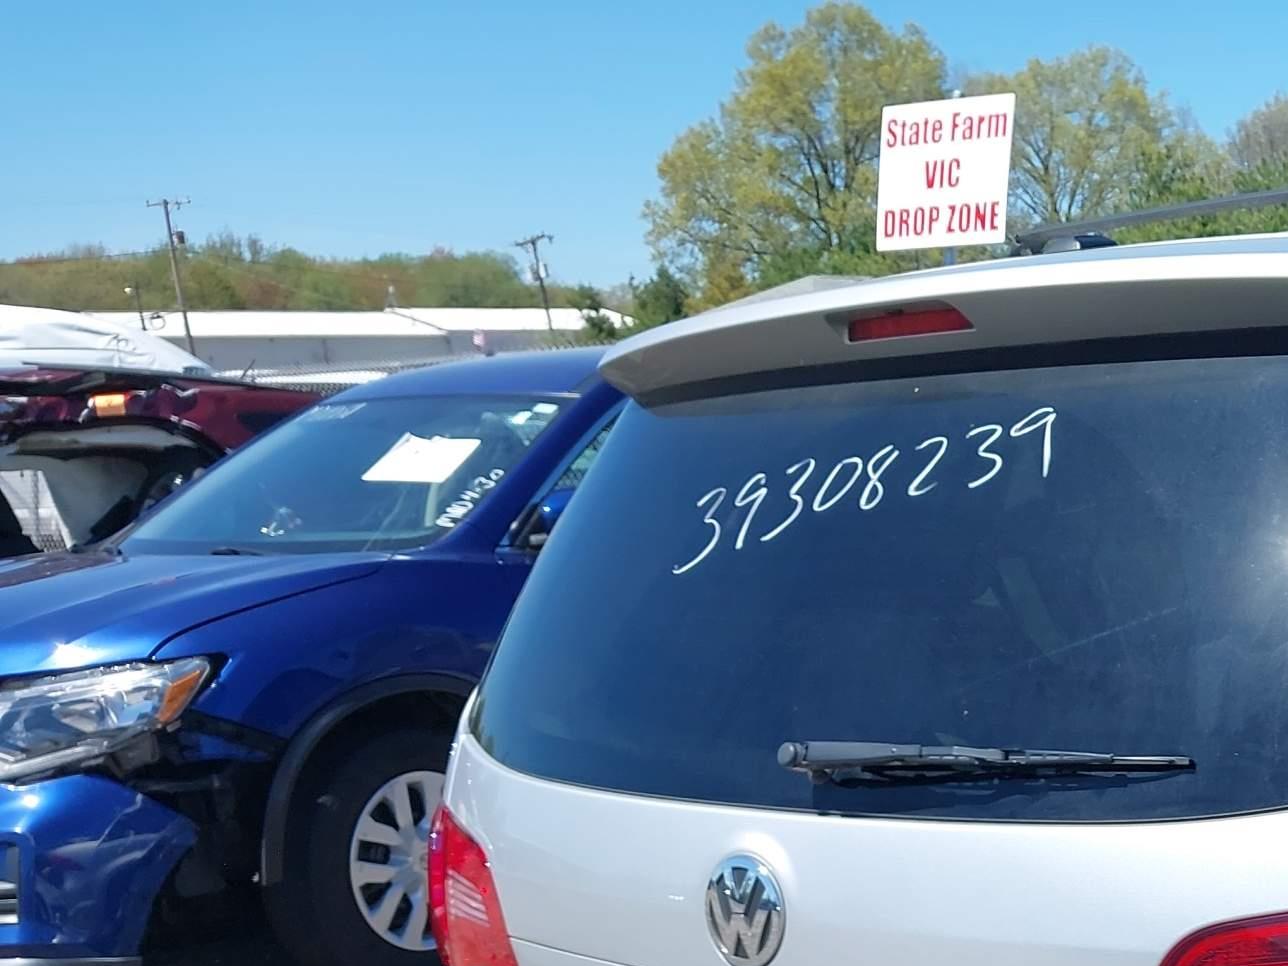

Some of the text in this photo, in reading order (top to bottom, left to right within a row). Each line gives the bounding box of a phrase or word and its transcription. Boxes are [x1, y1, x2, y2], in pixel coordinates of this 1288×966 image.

[886, 112, 1007, 148] State Farm
[925, 158, 960, 189] VIC
[884, 201, 1000, 238] DROP ZONE
[672, 407, 1057, 574] 39308239
